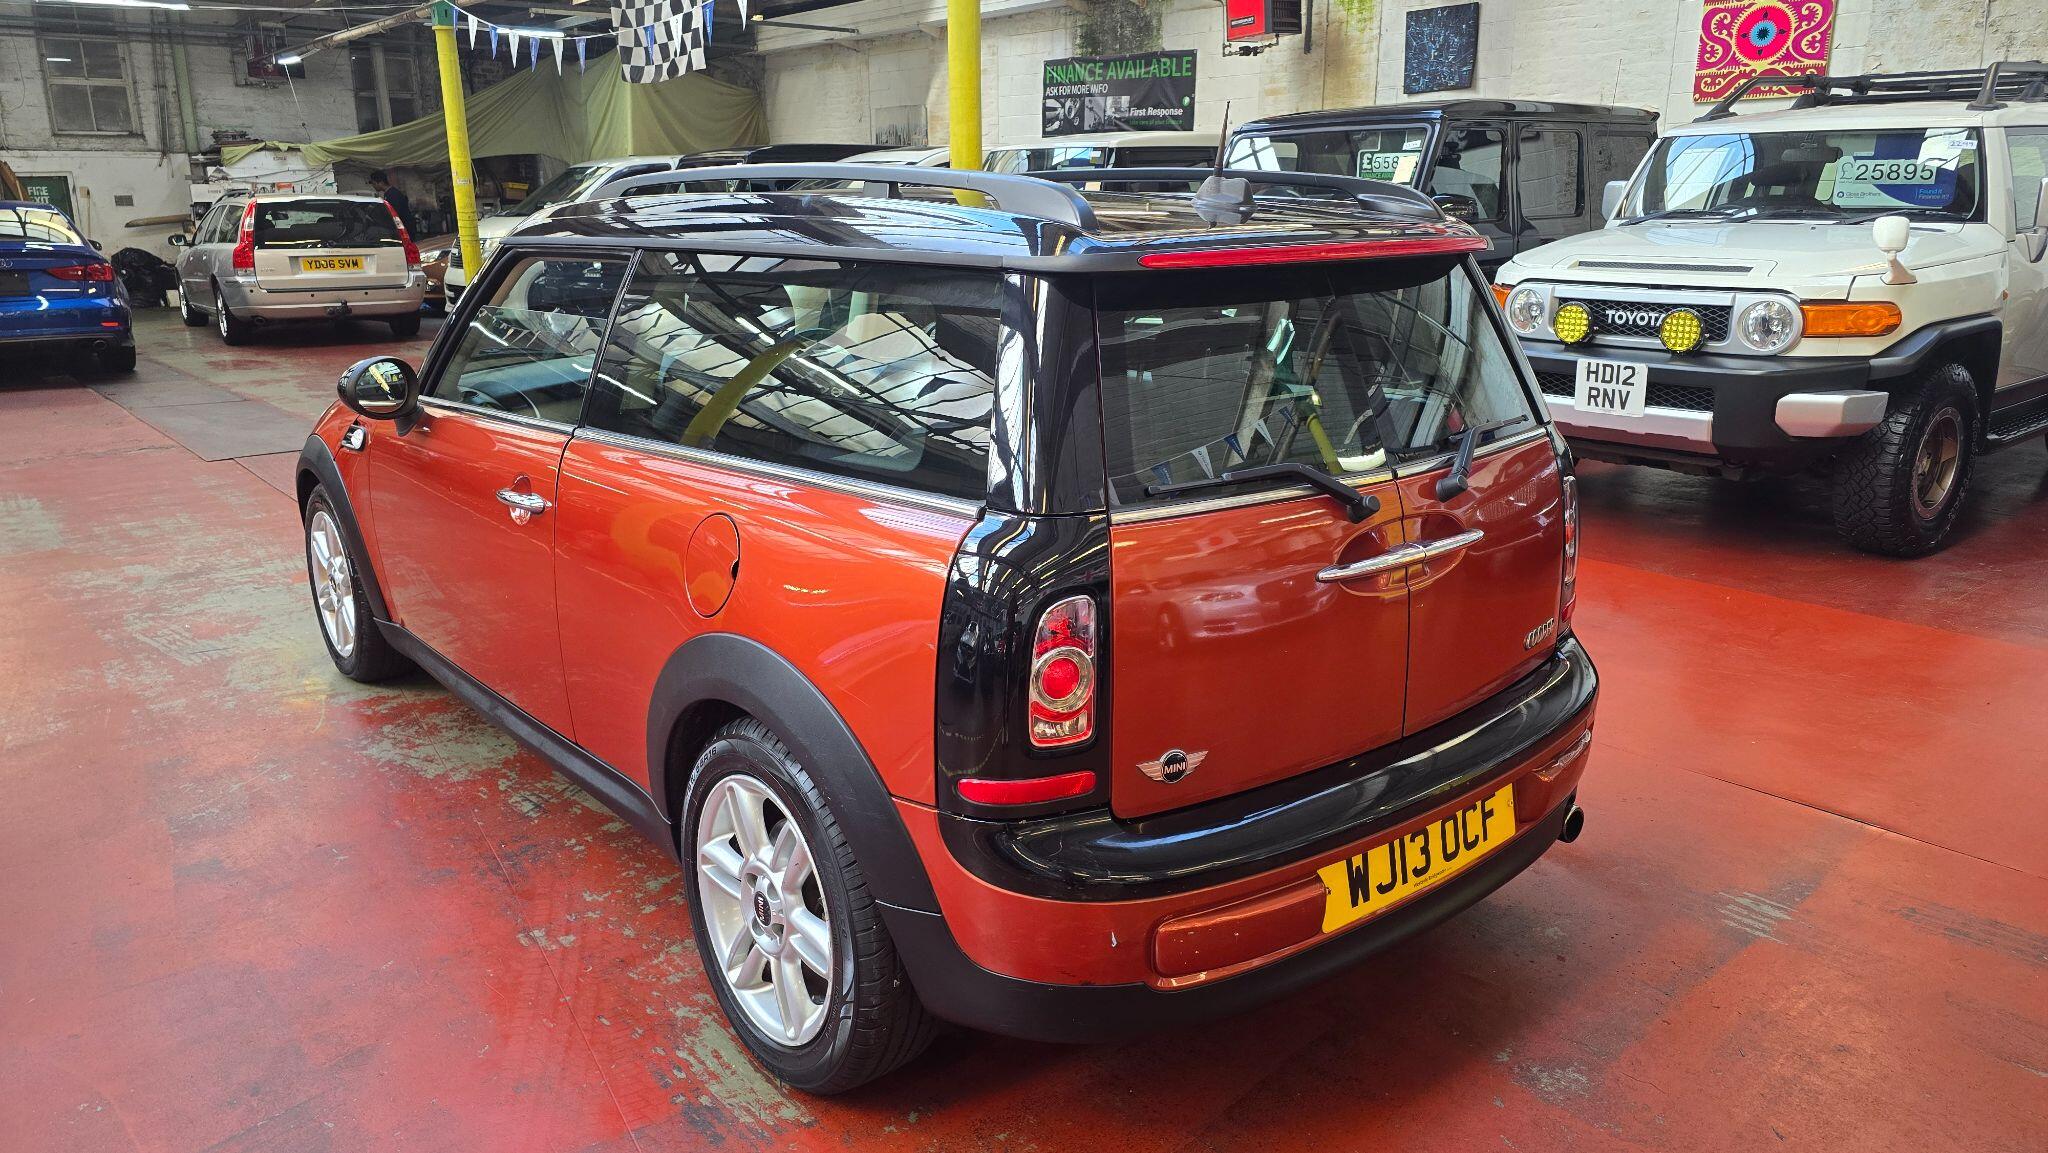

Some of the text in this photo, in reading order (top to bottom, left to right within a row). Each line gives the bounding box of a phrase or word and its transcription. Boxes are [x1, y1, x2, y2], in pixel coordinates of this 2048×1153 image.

[1045, 56, 1192, 83] FINANCE AVAILABLE
[1046, 83, 1108, 96] ASK FOR MORE INFO
[1130, 107, 1183, 117] First Response
[1362, 153, 1400, 170] £558
[1839, 162, 1934, 181] £25895
[27, 186, 48, 196] FIRE
[338, 259, 359, 269] SVM
[1586, 362, 1636, 386] HD12
[1587, 387, 1630, 410] RNV
[1164, 762, 1186, 775] MINI
[1345, 793, 1496, 908] WJ13 OCF
